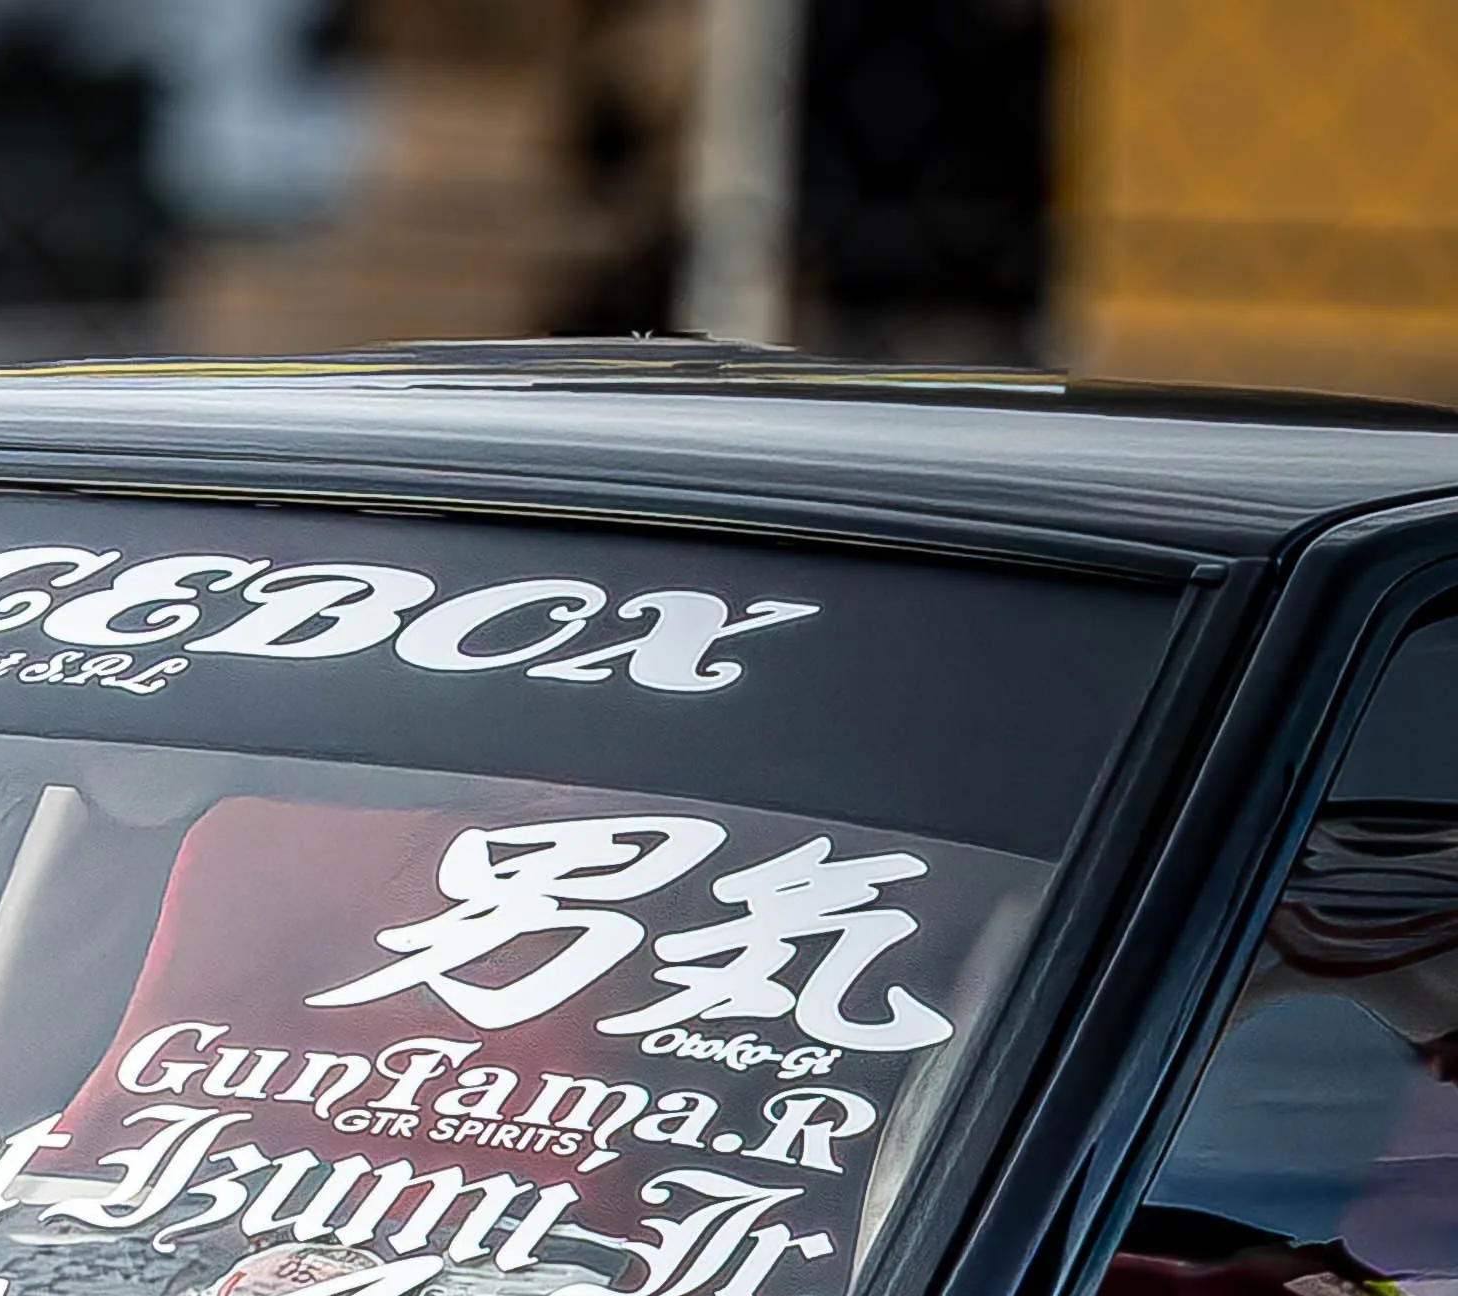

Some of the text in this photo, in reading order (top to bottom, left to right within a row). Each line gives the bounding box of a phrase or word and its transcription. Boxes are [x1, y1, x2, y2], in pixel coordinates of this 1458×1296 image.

[303, 814, 954, 1052] 男気
[334, 1107, 583, 1158] GTR SPIRITS
